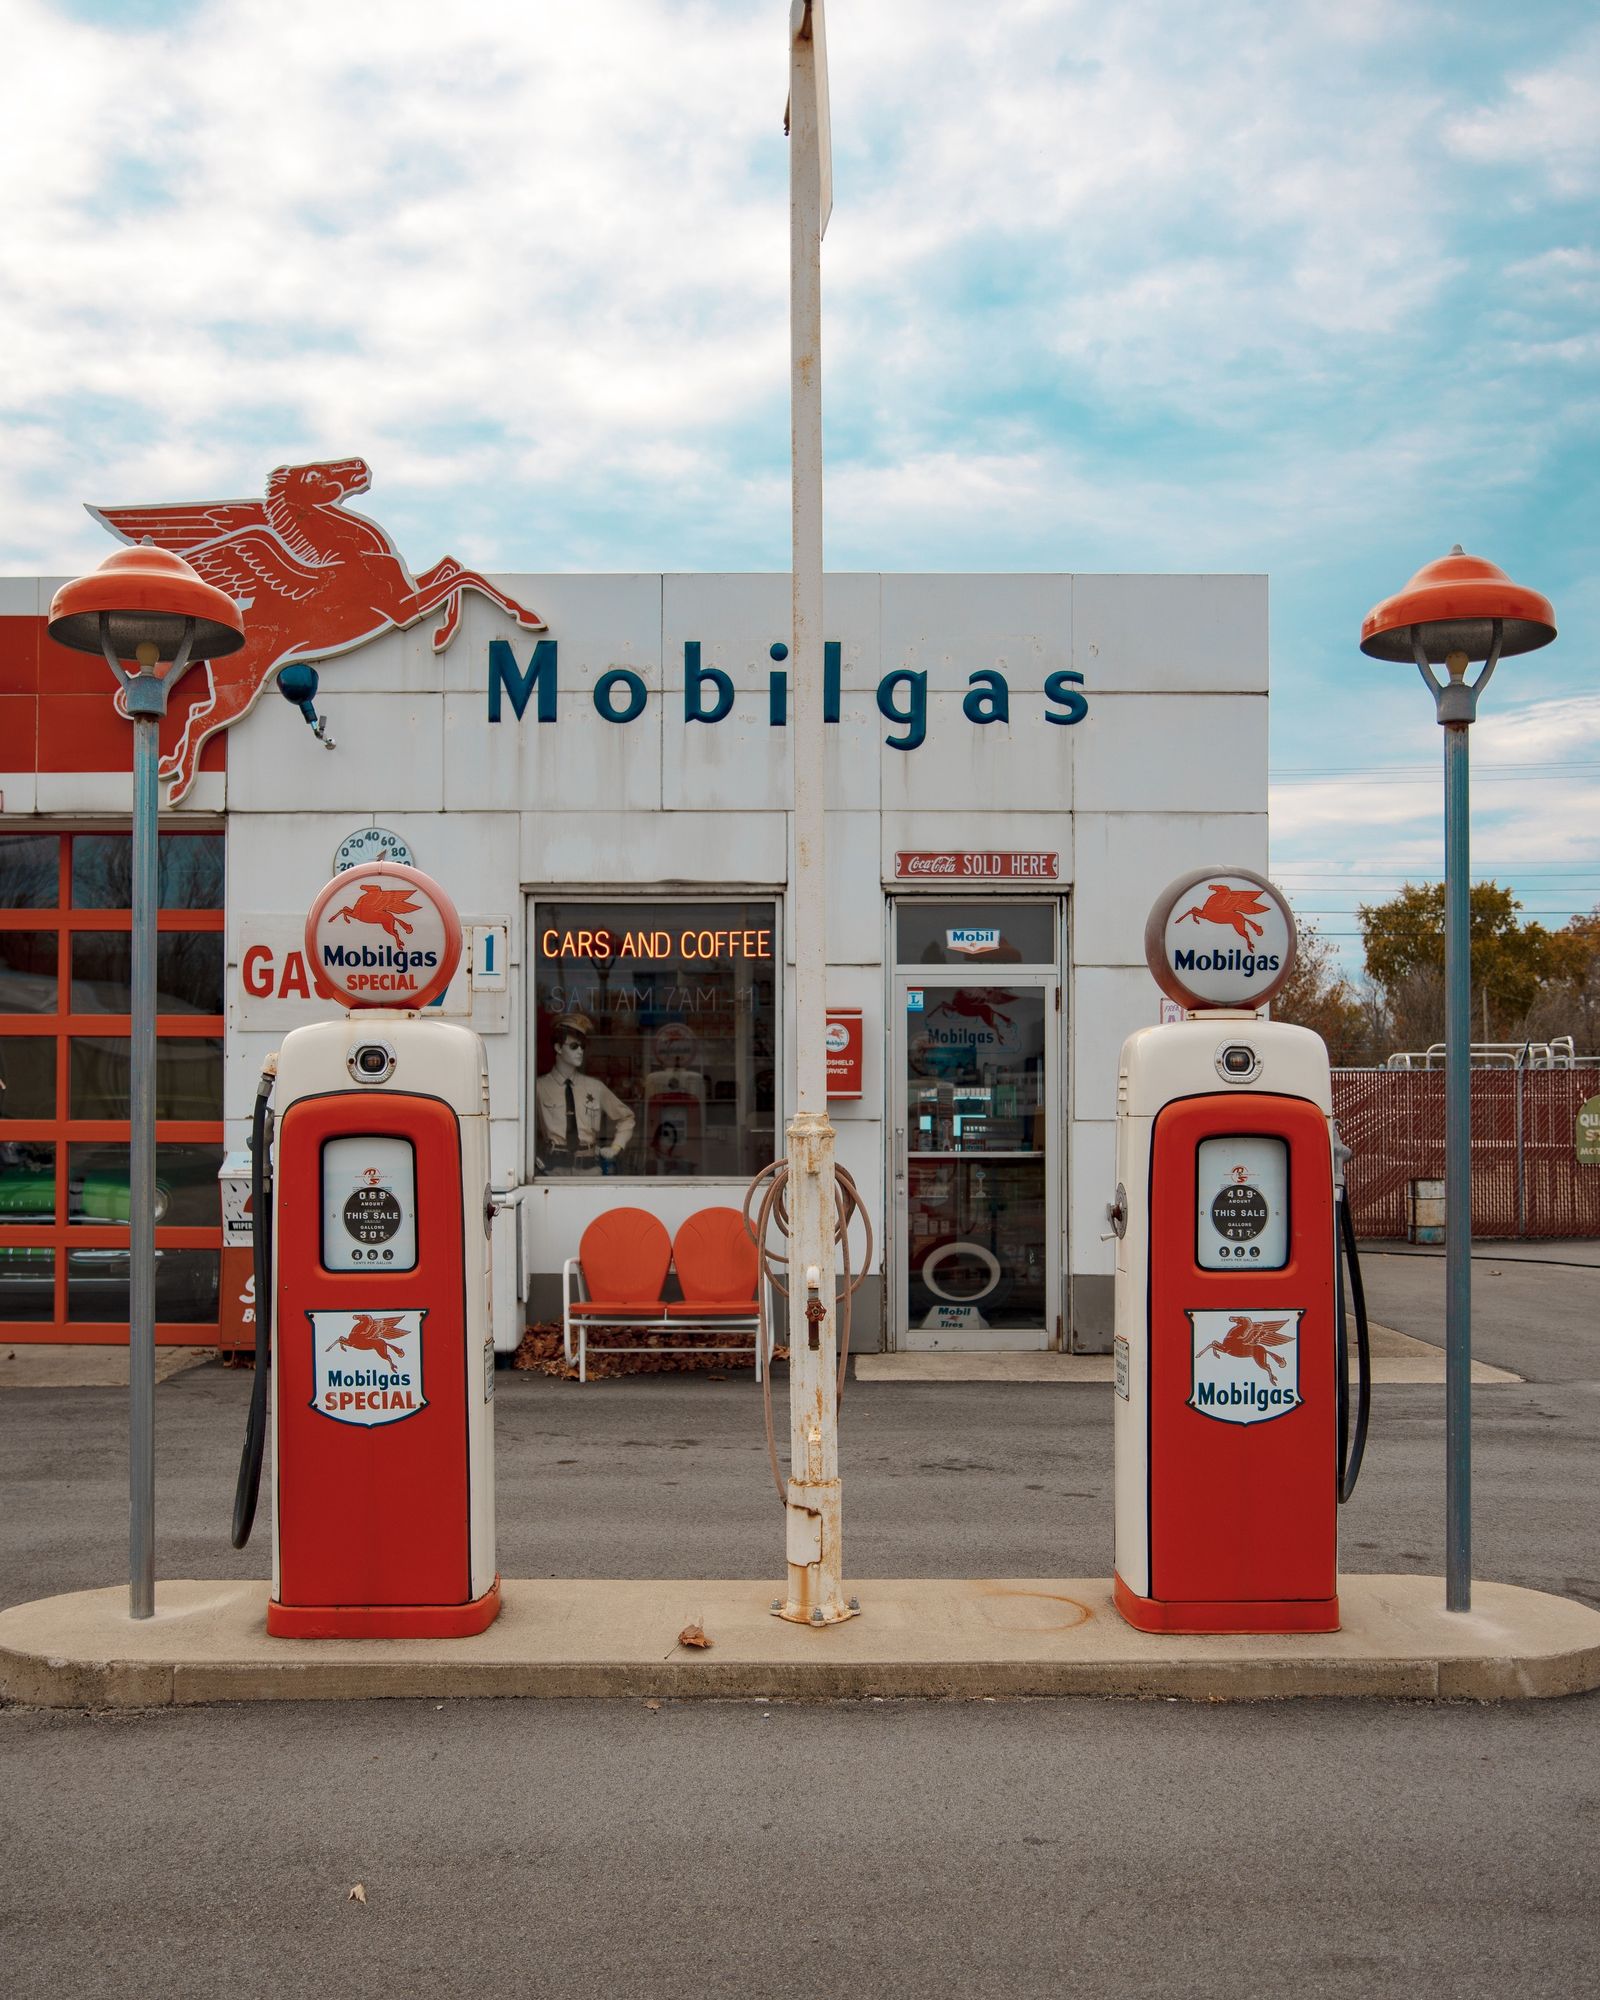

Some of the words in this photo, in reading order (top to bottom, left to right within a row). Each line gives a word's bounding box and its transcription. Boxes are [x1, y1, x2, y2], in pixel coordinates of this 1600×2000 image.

[488, 640, 1088, 750] Mobilgas
[349, 838, 364, 848] 20
[365, 832, 379, 841] 40
[381, 836, 396, 846] 60
[341, 847, 349, 857] 0
[391, 847, 406, 857] 80
[908, 856, 957, 873] Coca-Cola
[963, 855, 1001, 874] SOLD
[1011, 855, 1047, 875] HERE
[543, 929, 610, 959] CARS
[620, 930, 671, 958] AND
[681, 930, 771, 959] COFFEE
[952, 931, 994, 942] Mobil
[324, 945, 437, 973] Mobilgas
[1174, 949, 1280, 977] Mobilgas
[242, 945, 335, 999] GA
[347, 974, 418, 991] SPECIAL
[928, 1028, 994, 1048] Mobilgas
[1214, 1209, 1236, 1217] THIS
[1240, 1209, 1265, 1217] SALE
[938, 1307, 971, 1316] Mobil
[940, 1320, 964, 1329] Tires
[328, 1369, 411, 1391] Mobilgas
[325, 1391, 416, 1411] SPECIAL
[1198, 1381, 1295, 1412] Mobilgas
